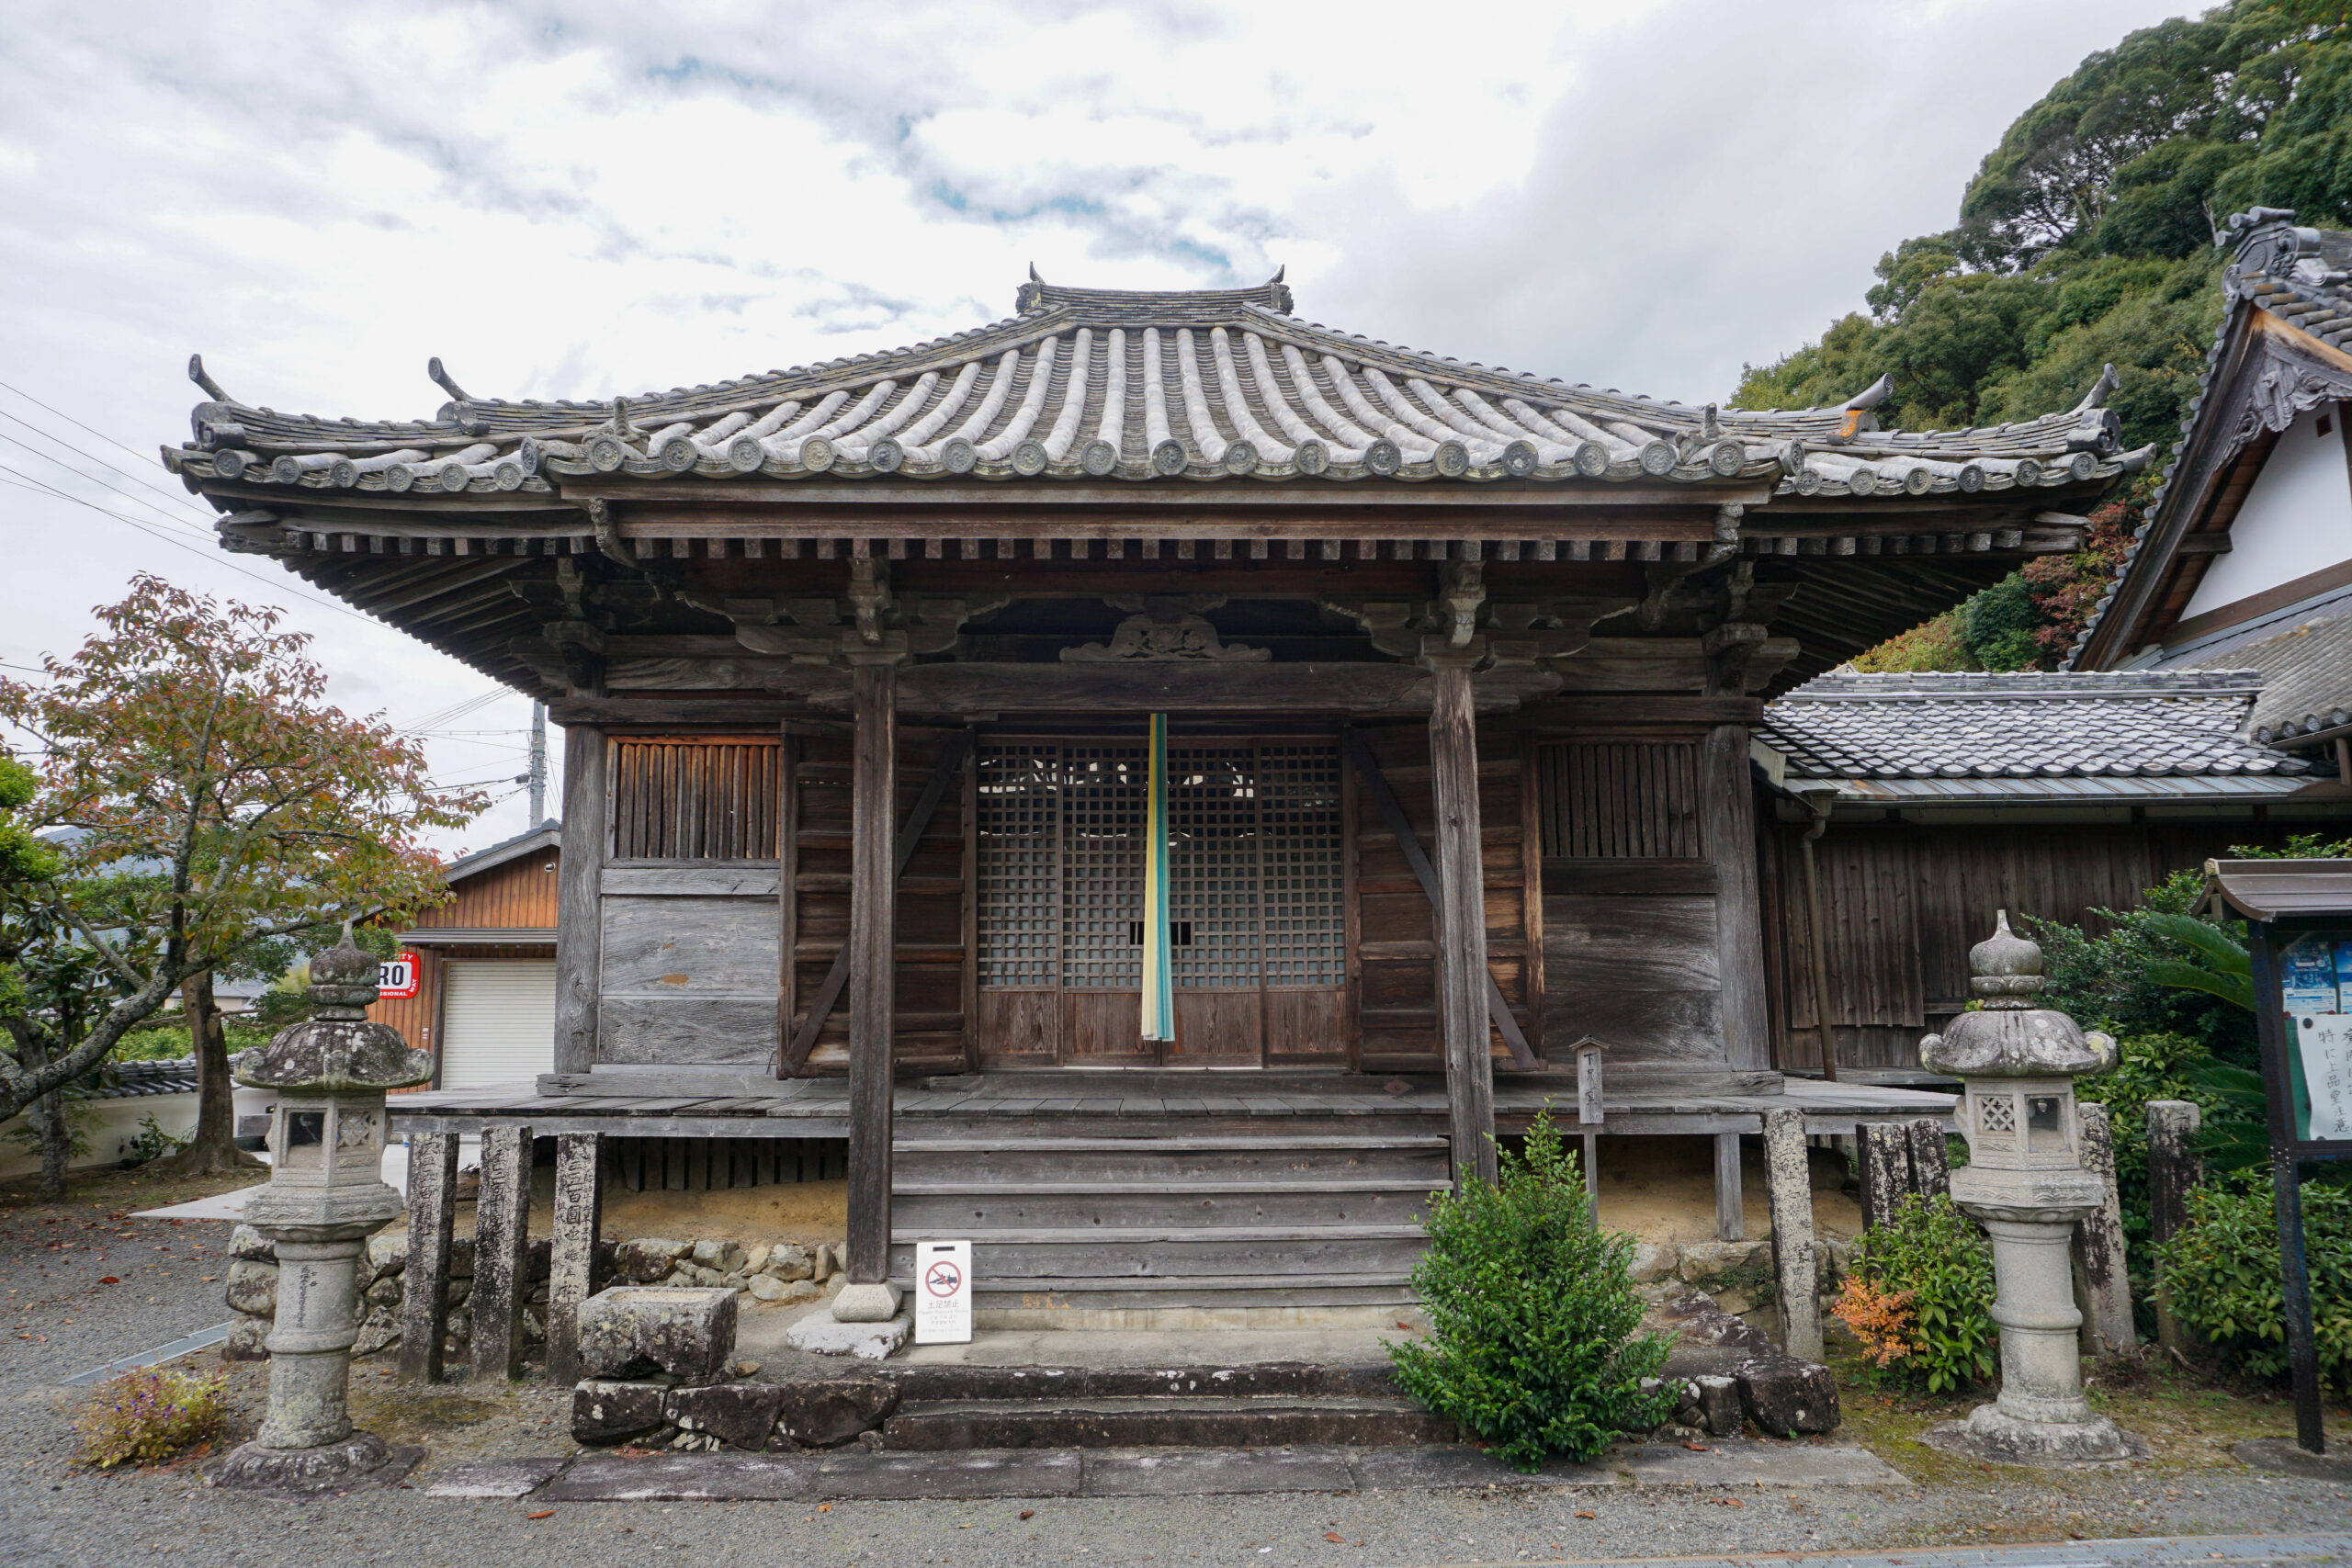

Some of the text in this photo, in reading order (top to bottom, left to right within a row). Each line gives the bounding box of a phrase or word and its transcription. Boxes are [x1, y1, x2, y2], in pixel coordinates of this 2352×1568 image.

[409, 979, 417, 992] WAY
[927, 1300, 960, 1308] 土足禁止
